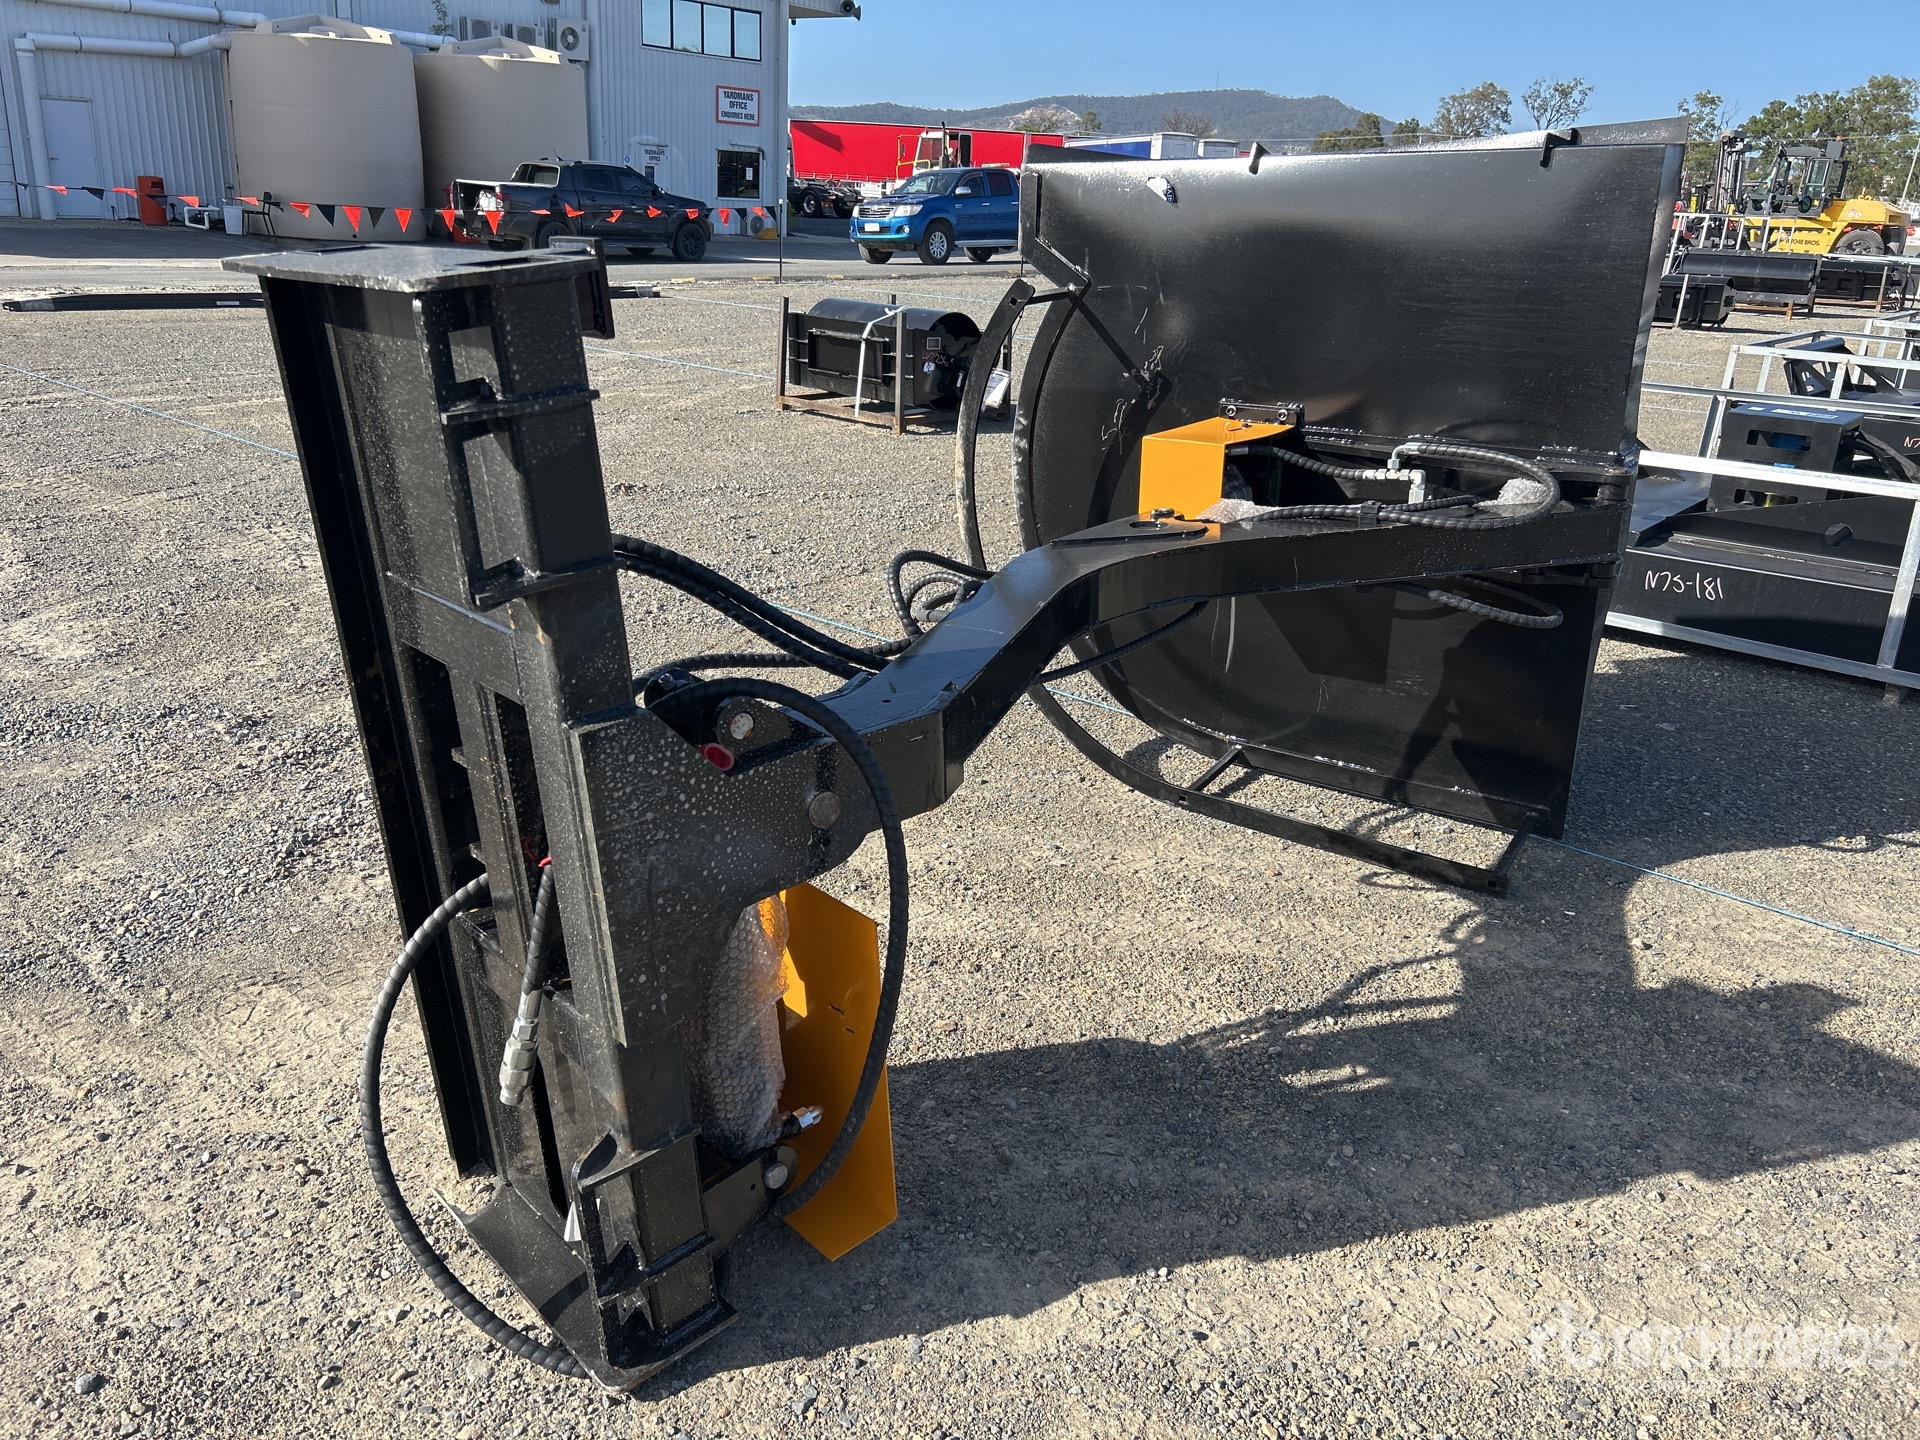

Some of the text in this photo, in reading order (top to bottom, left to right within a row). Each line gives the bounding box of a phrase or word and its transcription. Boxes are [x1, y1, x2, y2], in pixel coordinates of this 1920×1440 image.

[729, 100, 748, 110] OFFICE
[720, 110, 756, 121] ENQUIRIES HERE
